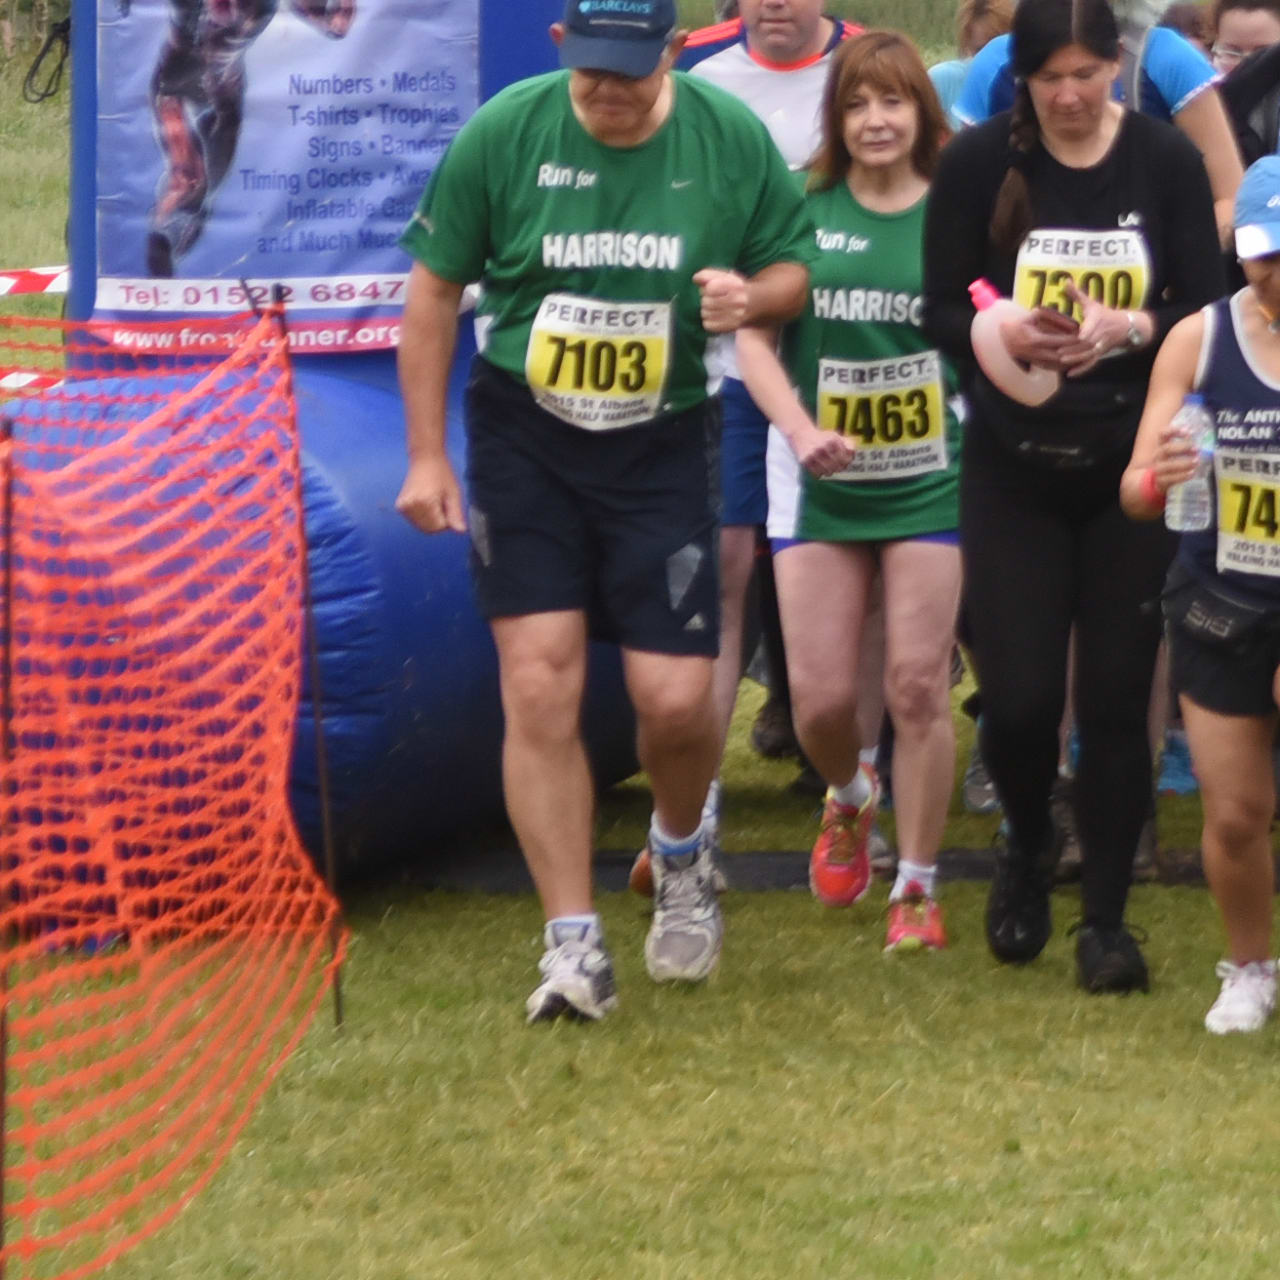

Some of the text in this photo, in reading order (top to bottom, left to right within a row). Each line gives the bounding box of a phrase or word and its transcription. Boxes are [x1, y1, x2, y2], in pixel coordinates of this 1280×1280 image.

[288, 72, 456, 96] Numbers Medals
[287, 103, 460, 127] T-shirts Trophies
[307, 137, 363, 163] Signs
[240, 162, 432, 195] Timing Clocks Awa
[537, 164, 596, 190] Run for
[286, 198, 376, 219] Inflatable
[257, 228, 398, 253] and Much Muc
[542, 232, 680, 270] HARRISON
[846, 234, 869, 253] for
[119, 280, 404, 306] Tel: 01522 6847
[812, 287, 925, 326] HARRISO
[545, 336, 648, 393] 7103
[828, 389, 930, 444] 7463
[1216, 410, 1240, 422] The
[1218, 426, 1272, 439] NOLAN
[870, 451, 884, 461] St
[888, 446, 932, 460] Albans
[1234, 541, 1266, 555] 2015
